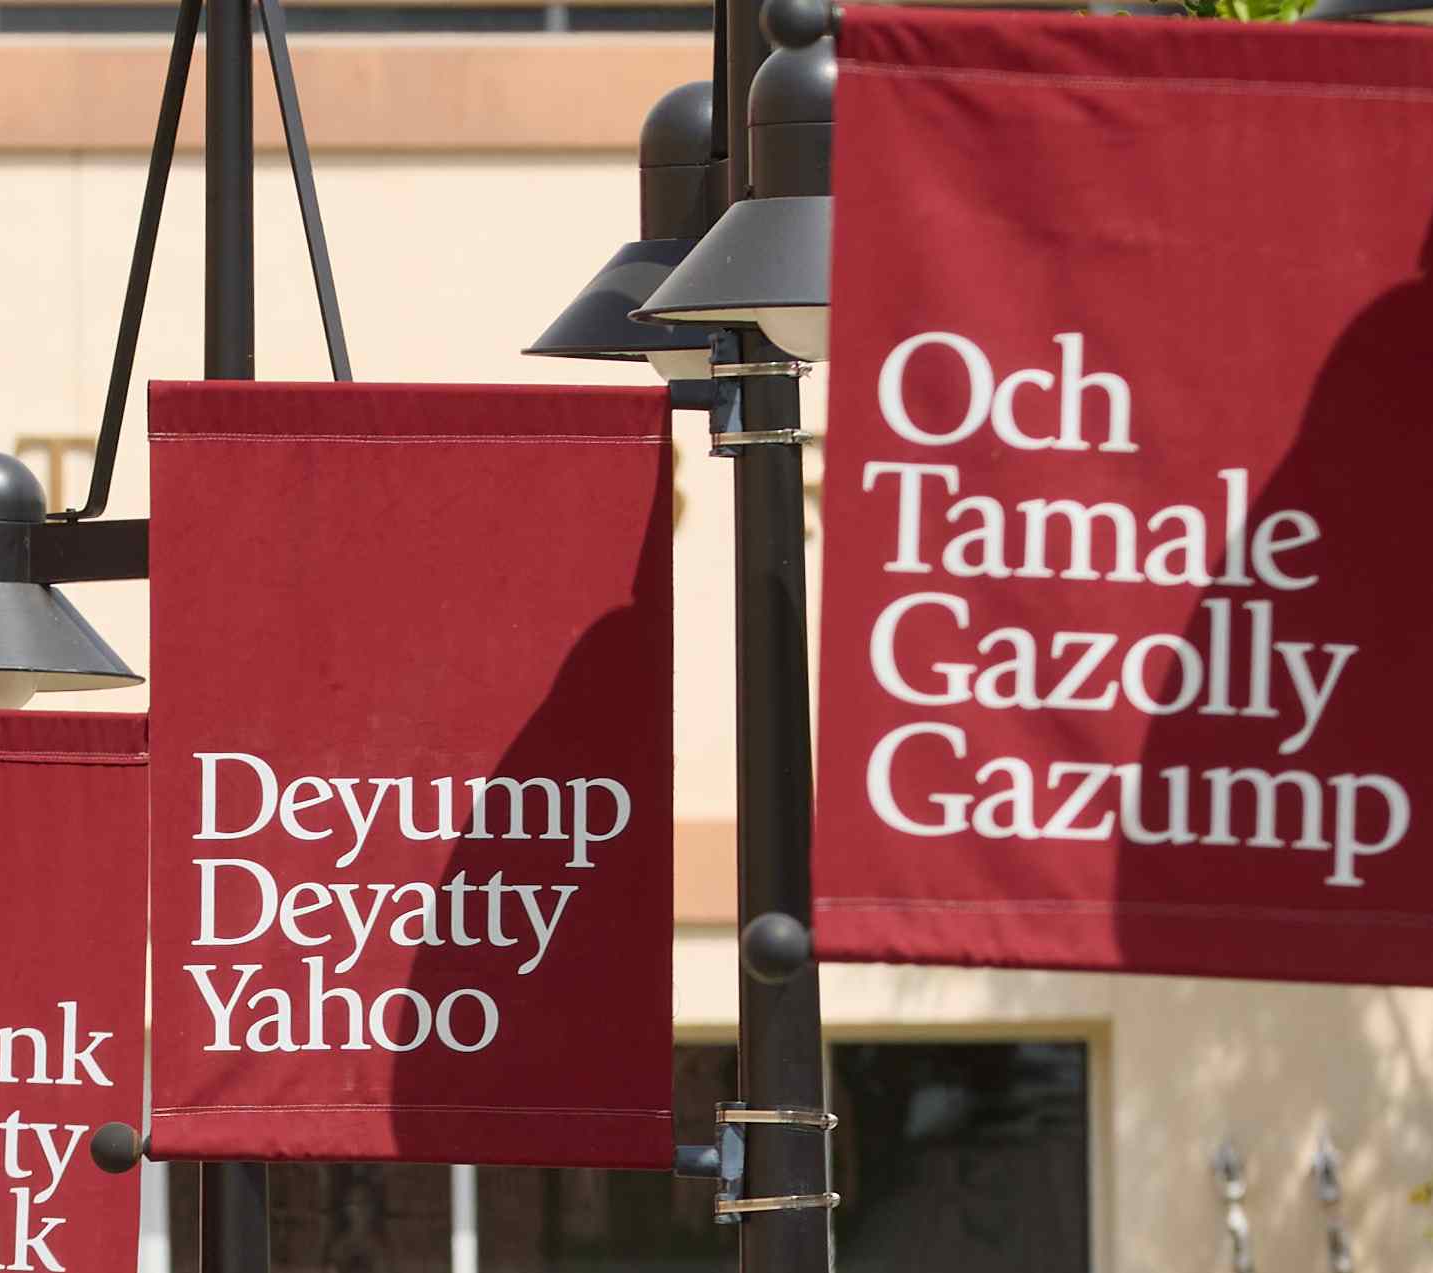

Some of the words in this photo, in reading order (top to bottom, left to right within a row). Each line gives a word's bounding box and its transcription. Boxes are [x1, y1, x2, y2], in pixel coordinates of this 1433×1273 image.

[878, 331, 1138, 453] Och
[862, 461, 1320, 590] Tamale
[869, 592, 1358, 755] Gazolly
[192, 752, 631, 869] Deyump
[865, 721, 1411, 887] Gazump
[190, 858, 579, 975] Deyatty
[182, 956, 499, 1053] Yahoo
